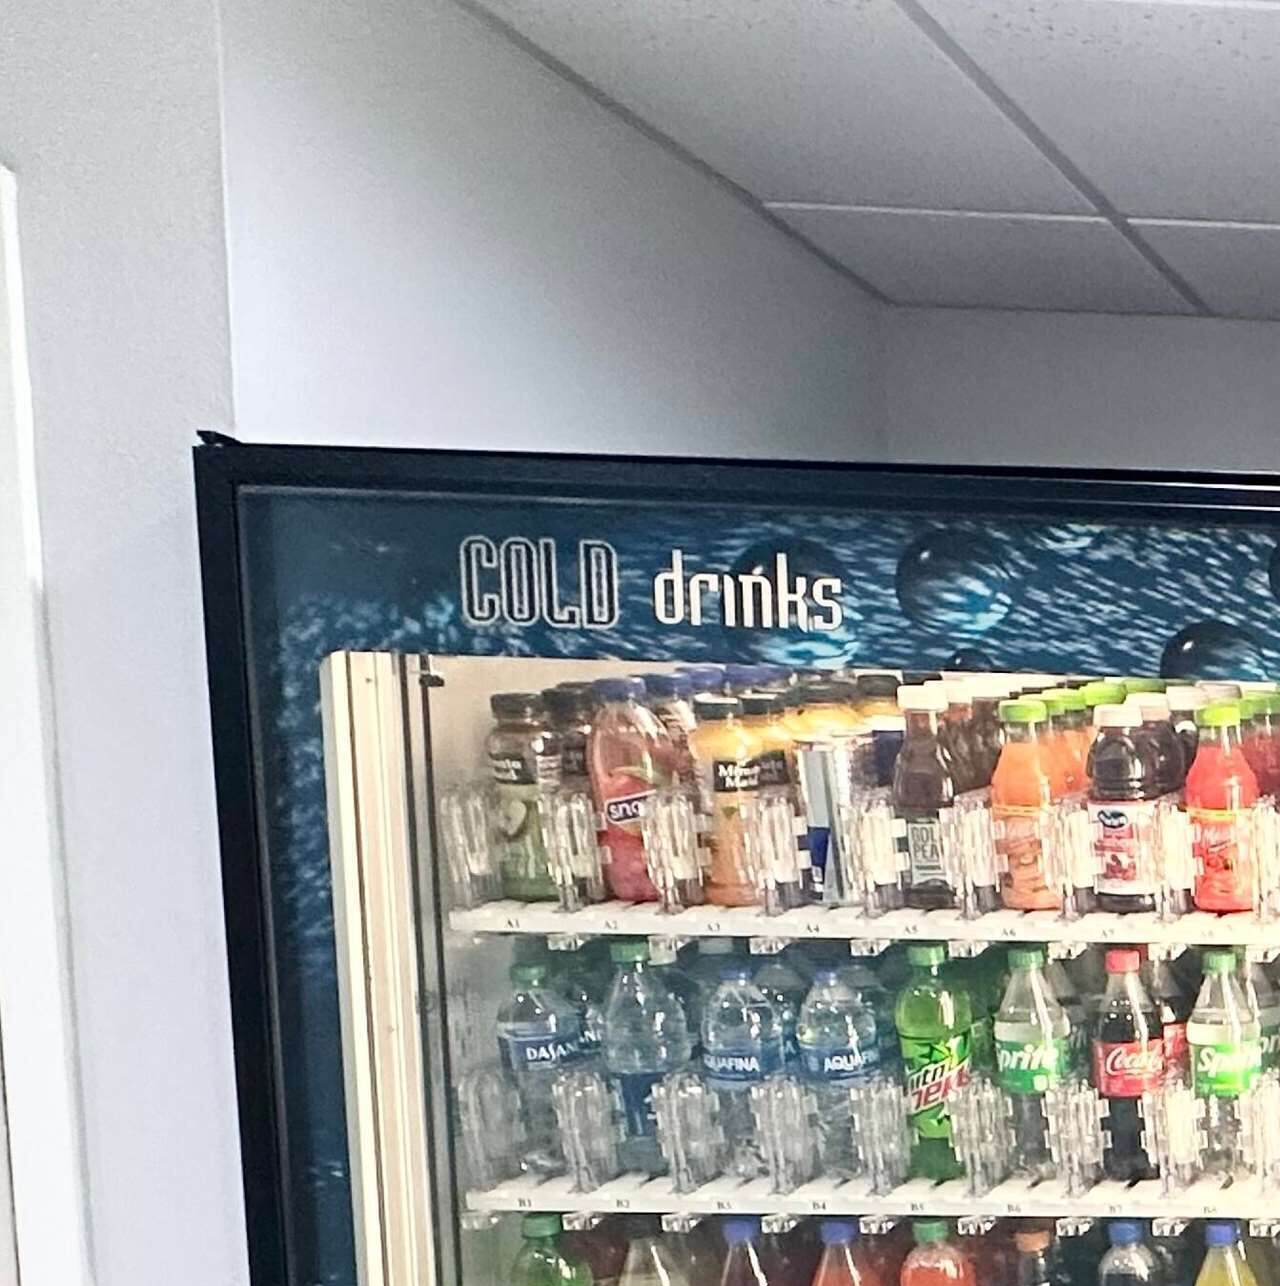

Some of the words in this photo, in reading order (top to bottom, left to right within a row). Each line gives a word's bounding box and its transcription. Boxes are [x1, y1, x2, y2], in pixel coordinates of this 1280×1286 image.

[459, 534, 620, 630] COLD
[653, 550, 845, 632] drinks
[912, 843, 940, 861] PEA
[505, 919, 519, 929] A1
[603, 920, 617, 930] A2
[806, 924, 819, 933] A4
[904, 926, 918, 934] A5
[1001, 928, 1016, 937] A6
[526, 1041, 579, 1062] DASAN
[704, 1055, 760, 1074] QUAFINA
[518, 1198, 532, 1208] B1
[616, 1199, 630, 1208] B2
[812, 1200, 826, 1210] B4
